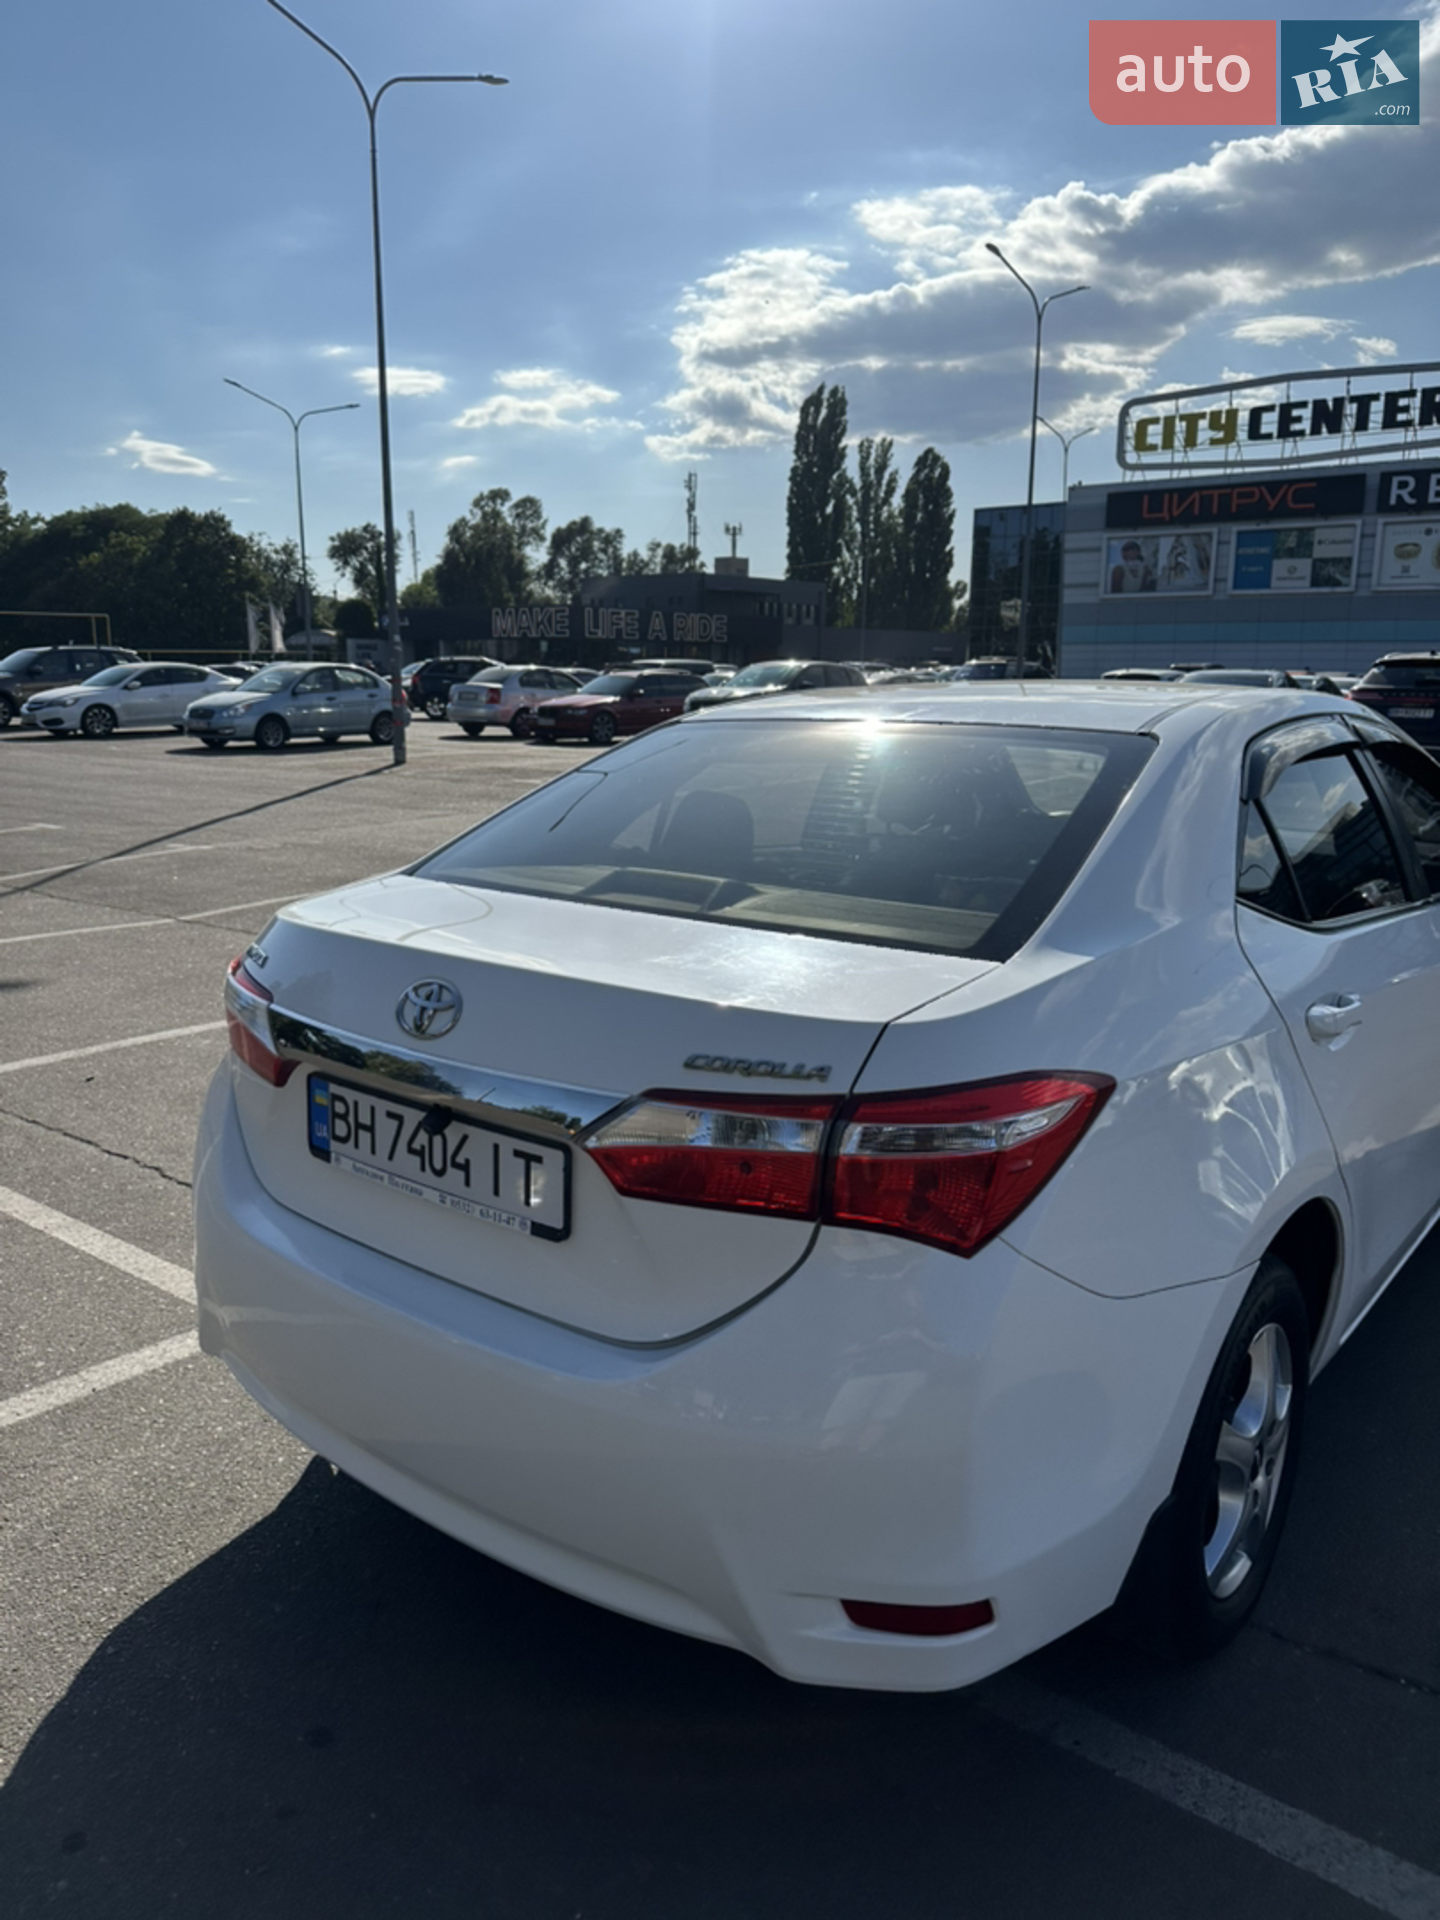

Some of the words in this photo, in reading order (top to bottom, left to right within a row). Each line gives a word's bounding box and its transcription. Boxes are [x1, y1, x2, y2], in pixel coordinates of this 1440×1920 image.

[1134, 408, 1239, 453] CITY
[1247, 387, 1440, 441] CENTER
[1142, 482, 1318, 521] ЦИТРУС
[492, 607, 570, 637] MAKE
[585, 608, 639, 639] LIFE
[648, 611, 667, 640] A
[674, 613, 728, 642] RIDE
[682, 1053, 833, 1083] COROLLA
[315, 1123, 328, 1138] UA
